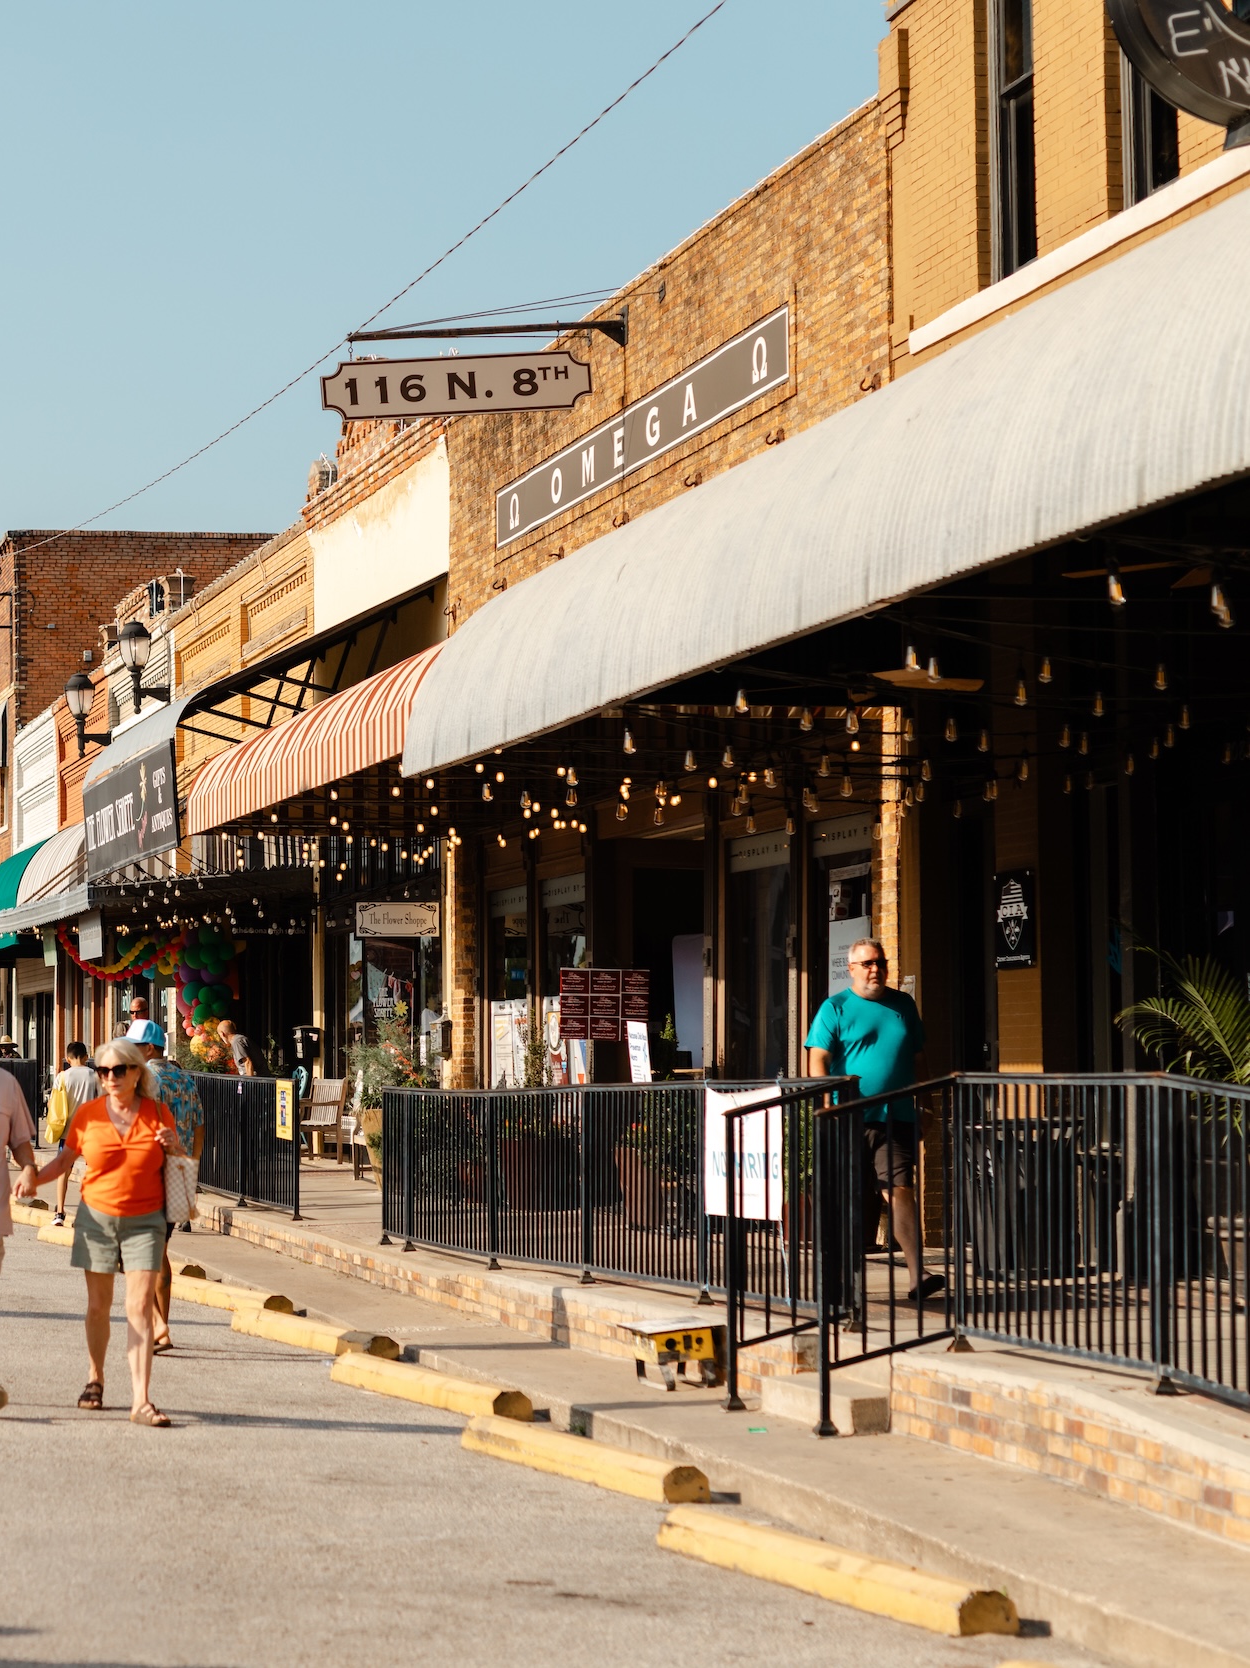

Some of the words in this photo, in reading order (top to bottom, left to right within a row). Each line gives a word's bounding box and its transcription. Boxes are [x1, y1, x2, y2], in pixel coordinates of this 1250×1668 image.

[344, 374, 427, 406] 116
[446, 370, 494, 401] N.
[512, 365, 570, 397] 8TH
[550, 382, 698, 504] OMEGA
[152, 766, 166, 789] GIFTS
[85, 813, 97, 852] THE
[95, 803, 117, 848] FLOWER
[115, 791, 136, 838] SHOPPE
[151, 807, 173, 834] ANTIQUES
[368, 911, 381, 925] The
[382, 911, 404, 925] Flower
[404, 911, 428, 928] Shoppe
[1001, 904, 1024, 917] CIA
